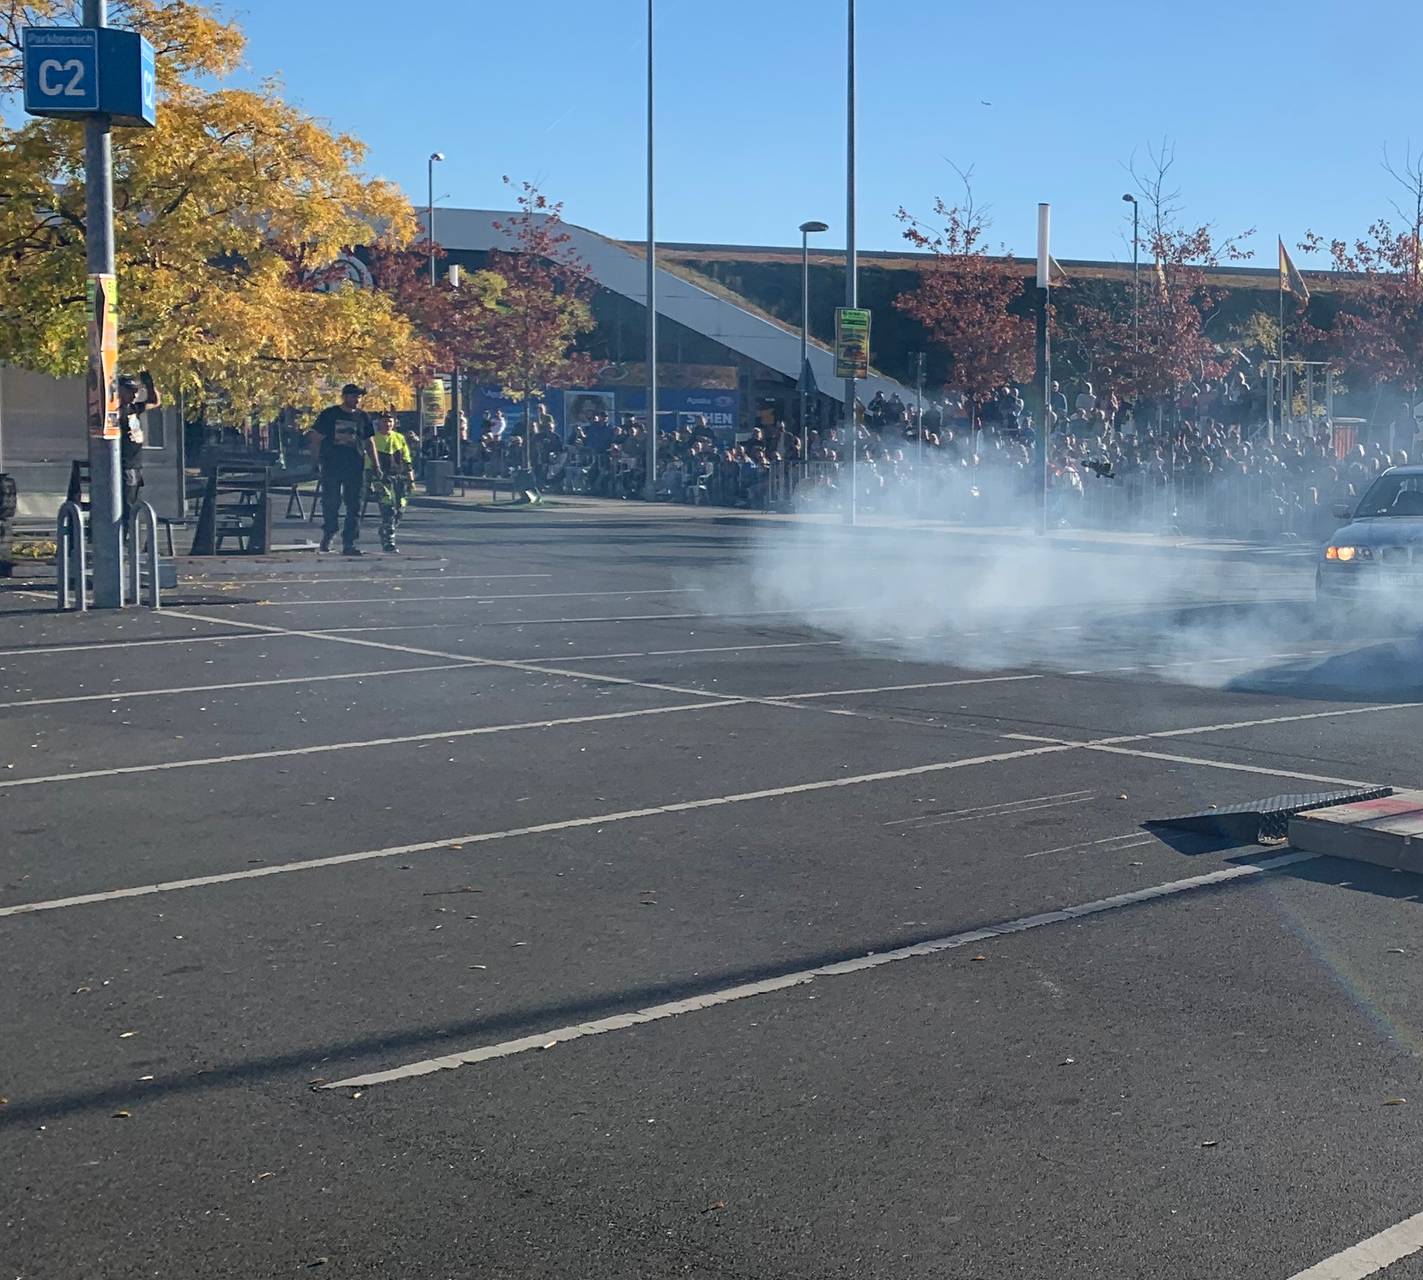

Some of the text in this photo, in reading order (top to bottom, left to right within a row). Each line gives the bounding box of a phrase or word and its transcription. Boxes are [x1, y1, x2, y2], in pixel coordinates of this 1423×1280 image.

[27, 32, 94, 44] Parkbereich
[39, 59, 86, 96] C2
[686, 413, 733, 424] SHEN
